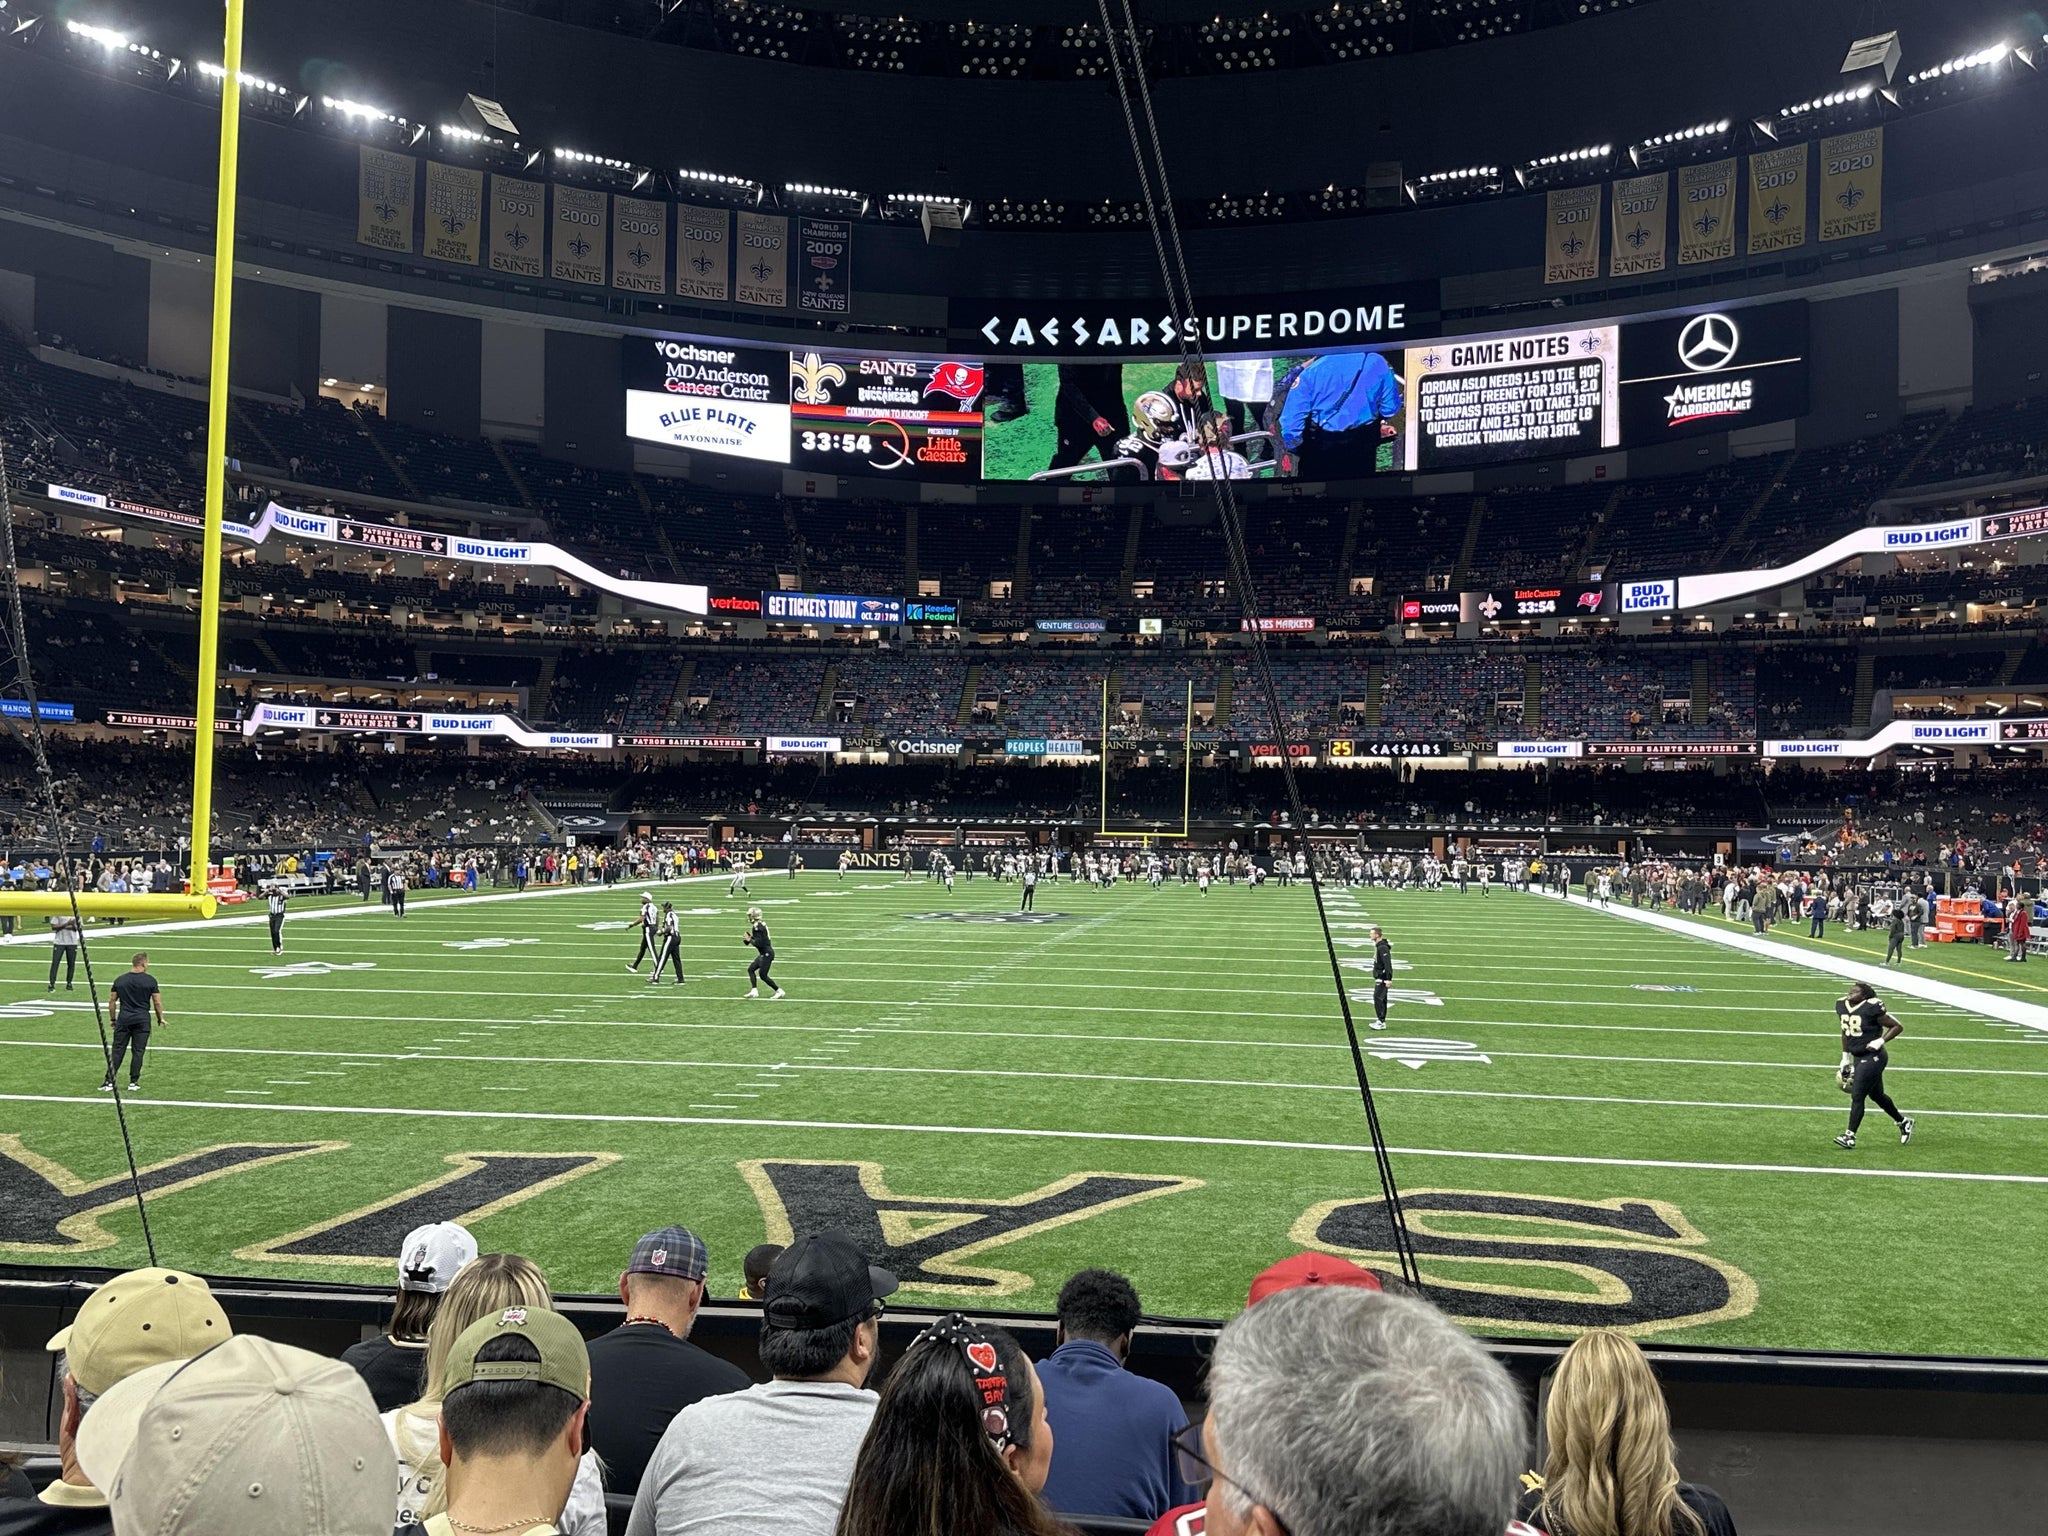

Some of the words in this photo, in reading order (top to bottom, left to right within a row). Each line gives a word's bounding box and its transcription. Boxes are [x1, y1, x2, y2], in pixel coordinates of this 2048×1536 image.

[1828, 154, 1874, 176] 2020
[1757, 171, 1798, 191] 2019
[1688, 184, 1727, 202] 2018
[500, 198, 535, 218] 1991
[1621, 196, 1659, 215] 2017
[560, 208, 600, 227] 2000
[1556, 208, 1590, 225] 2011
[620, 218, 660, 237] 2006
[811, 221, 839, 231] WORLD
[1823, 219, 1876, 239] SAINTS
[684, 226, 722, 243] 2009
[802, 228, 848, 239] CHAMPIONS
[743, 234, 781, 250] 2009
[806, 240, 843, 255] 2009
[1752, 232, 1802, 251] SAINTS
[430, 249, 472, 261] HOLDERS
[1681, 244, 1731, 262] SAINTS
[493, 257, 539, 275] SAINTS
[1614, 257, 1661, 274] SAINTS
[555, 265, 601, 283] SAINTS
[1548, 266, 1595, 281] SAINTS
[616, 276, 662, 292] SAINTS
[680, 283, 725, 298] SAINTS
[739, 290, 783, 305] SAINTS
[802, 296, 845, 310] SAINTS
[981, 315, 1178, 346] CAESARS
[1183, 302, 1407, 342] SUPERDOME
[665, 342, 736, 364] Ochsner
[1451, 343, 1504, 367] GAME
[1509, 336, 1570, 361] NOTES
[665, 362, 695, 379] MD
[696, 364, 769, 387] Anderson
[859, 360, 917, 377] SAINTS
[883, 375, 893, 385] VS
[1420, 378, 1460, 395] JORDAN
[1461, 376, 1487, 392] ASLO
[1489, 373, 1521, 389] NEEDS
[1523, 371, 1540, 385] 1.5
[1541, 369, 1555, 382] TO
[1557, 366, 1575, 381] TIE
[1579, 363, 1600, 378] HOF
[664, 377, 720, 397] Cancer
[720, 382, 770, 401] Center
[1422, 395, 1436, 408] DE
[1439, 390, 1478, 406] DWIGHT
[1481, 387, 1526, 403] FREENEY
[1527, 385, 1547, 399] FOR
[1549, 380, 1579, 396] 19TH,
[1580, 379, 1598, 392] 2.0
[1664, 380, 1752, 408] AMERICAS
[845, 406, 890, 419] COUNTDOWN
[890, 409, 901, 419] TO
[901, 409, 930, 420] KICKOFF
[1420, 408, 1433, 421] TO
[1435, 404, 1481, 421] SURPASS
[1483, 400, 1528, 416] FREENEY
[1530, 398, 1543, 412] TO
[1545, 395, 1572, 410] TAKE
[1573, 392, 1600, 407] 19TH
[1673, 399, 1752, 418] CARDROOM.NET
[659, 407, 702, 428] BLUE
[706, 408, 757, 435] PLATE
[1426, 418, 1479, 435] OUTRIGHT
[1480, 417, 1502, 430] AND
[1503, 415, 1519, 428] 2.5
[1521, 413, 1534, 426] TO
[1536, 411, 1555, 425] TIE
[1556, 408, 1578, 423] HOF
[1579, 407, 1593, 421] LB
[673, 433, 743, 446] MAYONNAISE
[1435, 431, 1482, 448] DERRICK
[1482, 428, 1527, 443] THOMAS
[1528, 425, 1549, 440] FOR
[1550, 422, 1580, 437] 18TH.
[801, 431, 872, 454] 33:54
[926, 436, 961, 451] Little
[917, 447, 967, 462] Caesars
[59, 489, 75, 500] BUD
[76, 492, 97, 504] LIGHT
[2009, 512, 2041, 523] PATRON
[222, 522, 234, 531] BUD
[290, 518, 327, 533] LIGHT
[363, 527, 391, 538] PATRON
[393, 530, 422, 541] SAINTS
[1887, 532, 1923, 545] BUD
[1925, 526, 1970, 543] LIGHT
[362, 533, 423, 550] PARTNERS
[457, 543, 485, 556] BUD
[486, 545, 528, 559] LIGHT
[61, 557, 97, 569] SAINTS
[140, 568, 177, 580] SAINTS
[225, 578, 262, 591] SAINTS
[1631, 584, 1664, 597] BUD
[308, 588, 346, 599] SAINTS
[1515, 590, 1534, 599] Little
[1534, 589, 1560, 599] Caesars
[1880, 593, 1924, 605] SAINTS
[1979, 587, 2024, 599] SAINTS
[394, 595, 433, 606] SAINTS
[478, 602, 516, 612] SAINTS
[710, 597, 760, 611] verizon
[768, 596, 787, 615] GET
[788, 597, 826, 617] TICKETS
[827, 600, 858, 619] TODAY
[1517, 600, 1556, 614] 33:54
[1625, 593, 1670, 609] LIGHT
[925, 604, 956, 614] Keesler
[1422, 604, 1459, 613] TOYOTA
[925, 612, 955, 621] Federal
[1171, 619, 1205, 628] SAINTS
[1325, 618, 1361, 628] SAINTS
[992, 619, 1025, 629] SAINTS
[1037, 621, 1071, 630] VENTURE
[1073, 621, 1105, 630] GLOBAL
[1242, 618, 1274, 630] RSES
[1275, 618, 1314, 630] MARKETS
[2, 703, 33, 713] HANCOC
[39, 707, 74, 716] WHITNEY
[273, 710, 305, 722] LIGHT
[340, 712, 368, 720] PATRON
[122, 715, 154, 724] PATRON
[156, 717, 186, 726] SAINTS
[188, 719, 229, 730] PAERS
[340, 718, 398, 728] PARTNERS
[432, 718, 459, 729] BUD
[461, 719, 493, 729] LIGHT
[1914, 727, 1942, 737] BUD
[1945, 726, 1989, 737] LIGHT
[549, 736, 569, 744] BUD
[571, 736, 599, 745] LIGHT
[633, 738, 665, 746] PATRON
[702, 739, 747, 747] PARTNERS
[780, 740, 801, 748] BUD
[801, 740, 828, 748] LIGHT
[845, 738, 881, 746] SAINTS
[898, 740, 962, 755] Ochsner
[1006, 741, 1045, 753] PEOPLES
[1047, 741, 1081, 753] HEALTH
[1100, 741, 1137, 750] SAINTS
[1182, 741, 1220, 750] SAINTS
[1453, 742, 1494, 750] SAINTS
[1331, 742, 1351, 755] 25
[1370, 743, 1441, 755] CAESARS
[1513, 745, 1539, 753] BUD
[1540, 745, 1568, 754] LIGHT
[1605, 745, 1643, 753] PATRON
[1646, 745, 1683, 753] SAINTS
[1781, 744, 1805, 753] BUD
[1805, 744, 1840, 753] LIGHT
[712, 850, 756, 865] INTS
[975, 1376, 1007, 1390] TAMPA
[983, 1391, 1004, 1404] BAY
